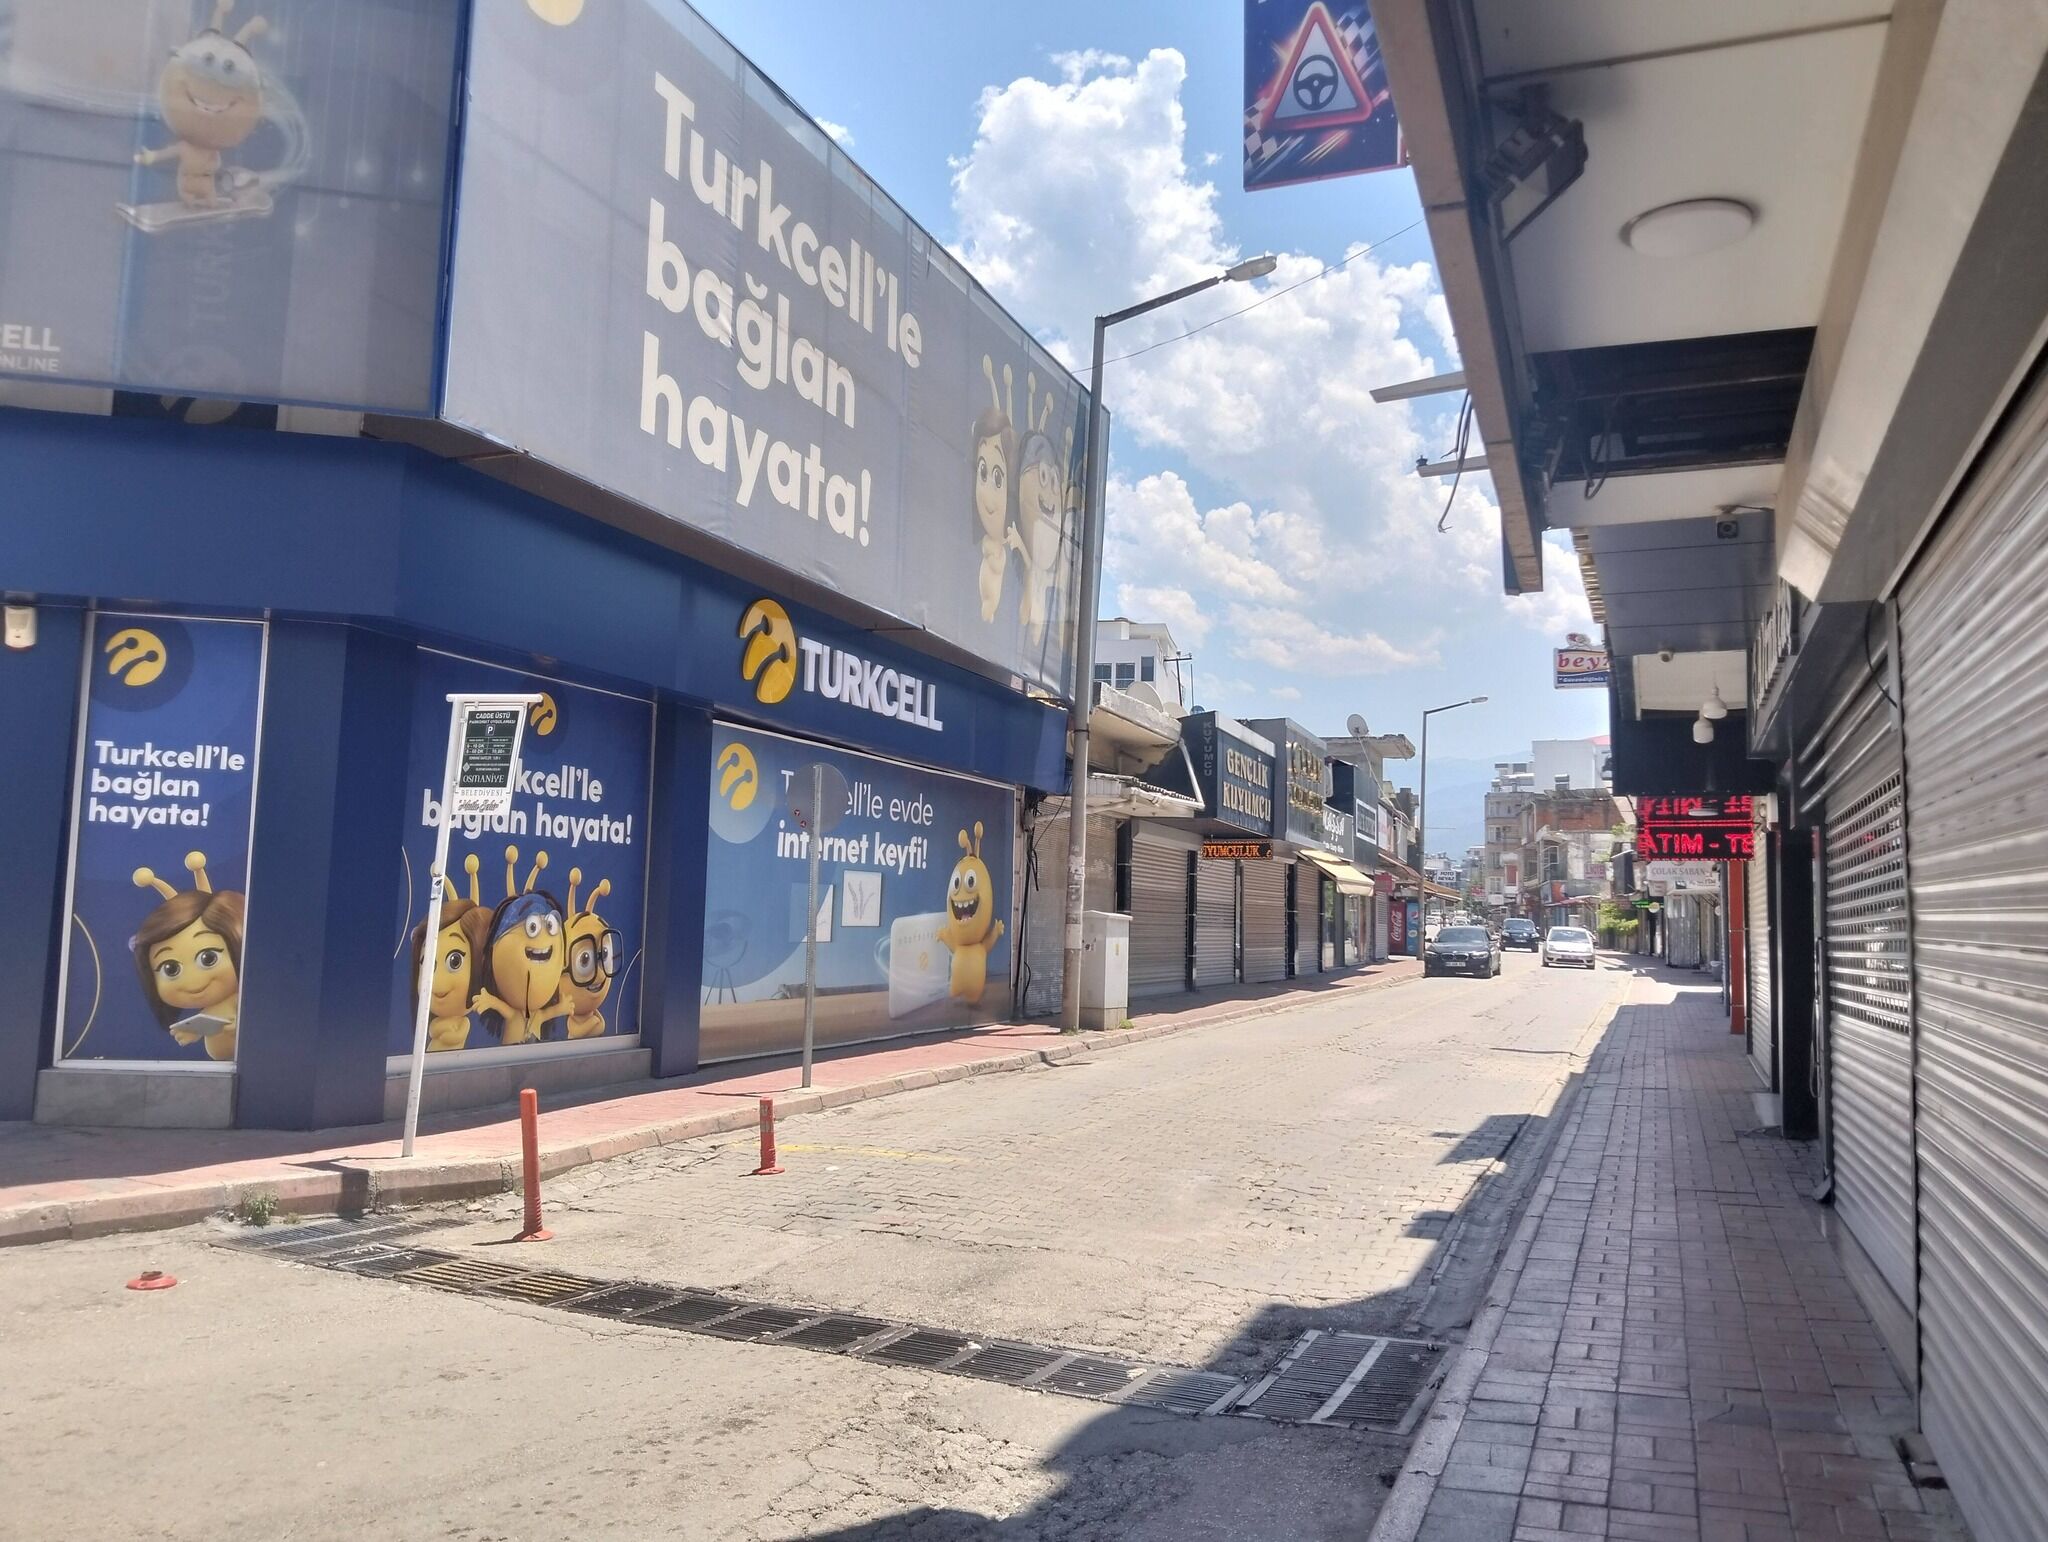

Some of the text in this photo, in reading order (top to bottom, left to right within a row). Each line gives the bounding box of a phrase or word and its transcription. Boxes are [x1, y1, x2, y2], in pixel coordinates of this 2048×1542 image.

[654, 71, 922, 368] Turkcell'le
[646, 198, 855, 428] bağlan
[0, 324, 61, 352] ELL
[640, 330, 871, 547] hayata!
[799, 637, 943, 732] TURKCELL
[488, 726, 494, 734] P
[1203, 721, 1214, 777] KUYUMCU
[94, 740, 246, 771] Turkcell'le
[1226, 748, 1269, 789] GENÇLİK
[91, 768, 199, 800] bağlan
[463, 772, 505, 783] OSMANİYE
[88, 797, 210, 829] hayata!
[889, 793, 933, 826] evde
[1223, 781, 1271, 822] KUYUMCU
[535, 802, 632, 848] hayata!
[874, 832, 928, 875] keyfi!
